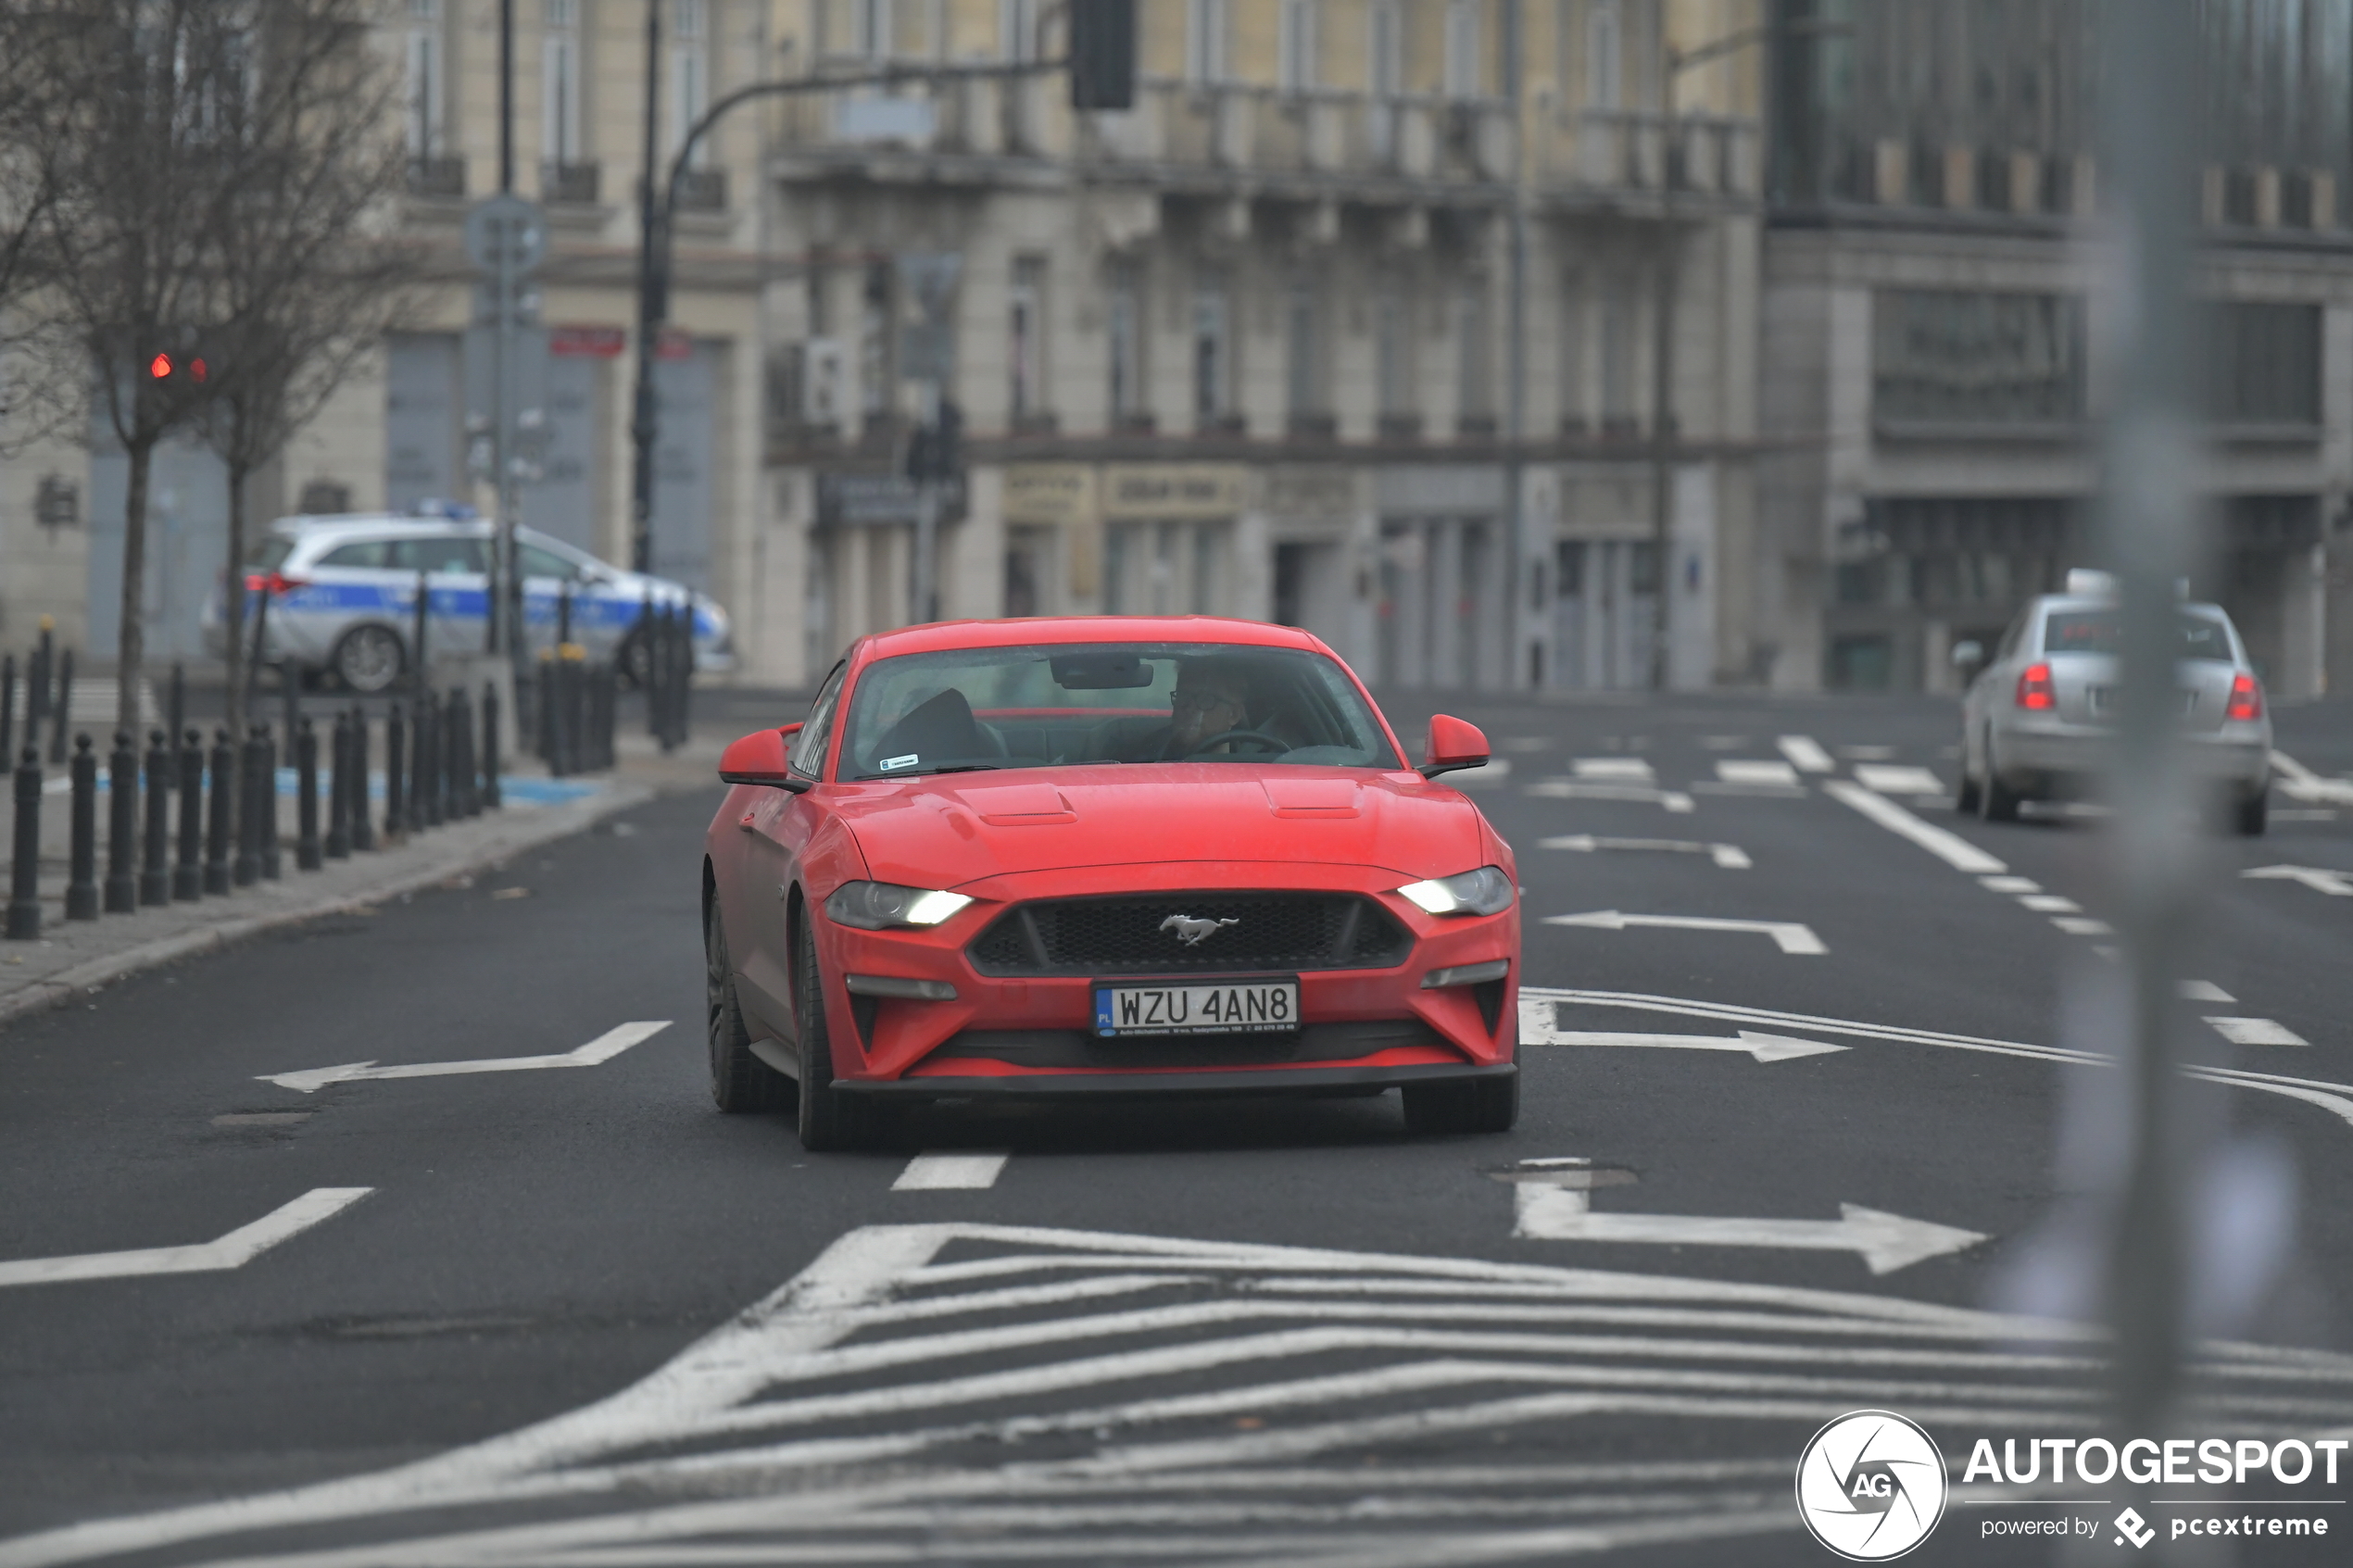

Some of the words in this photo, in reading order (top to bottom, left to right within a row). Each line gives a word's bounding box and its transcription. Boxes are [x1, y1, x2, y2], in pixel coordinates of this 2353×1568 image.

[1099, 1013, 1111, 1023] PL
[1120, 990, 1188, 1025] WZU
[1202, 987, 1289, 1022] 4AN8
